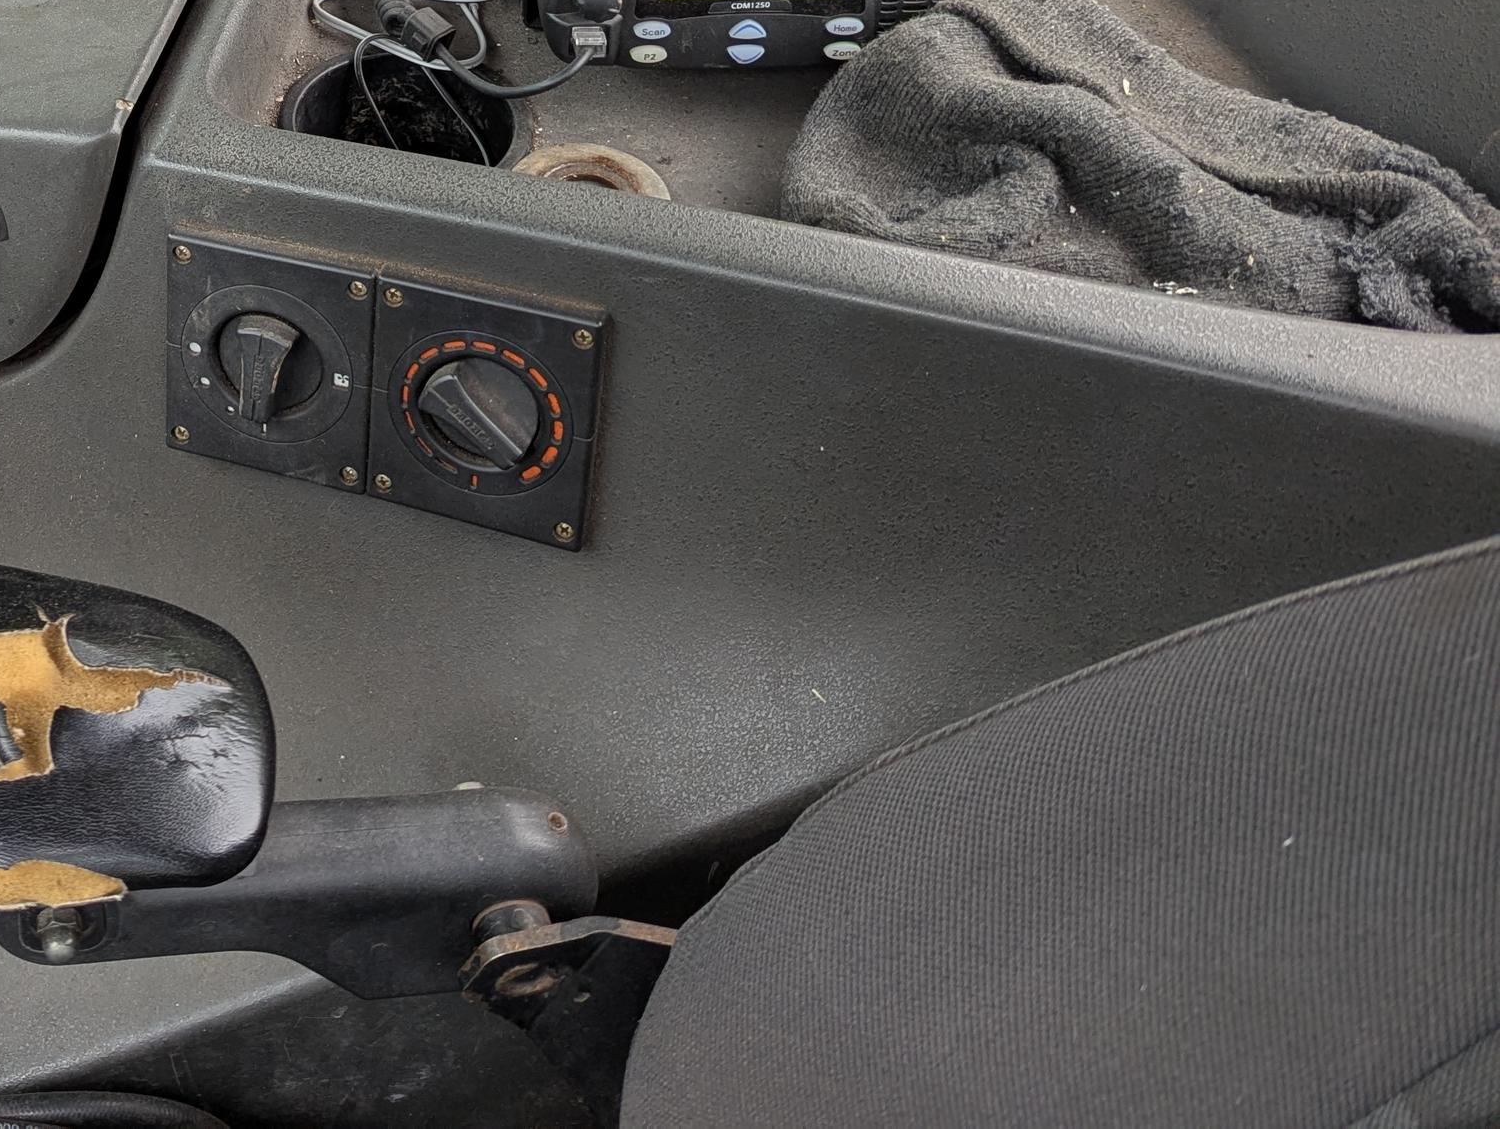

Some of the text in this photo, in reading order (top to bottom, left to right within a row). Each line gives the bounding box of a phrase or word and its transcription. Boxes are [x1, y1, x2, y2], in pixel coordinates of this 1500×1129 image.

[731, 1, 771, 10] CDM1250
[642, 27, 666, 37] Scan
[833, 24, 858, 33] Home
[643, 53, 657, 61] P2
[832, 49, 858, 57] Zone
